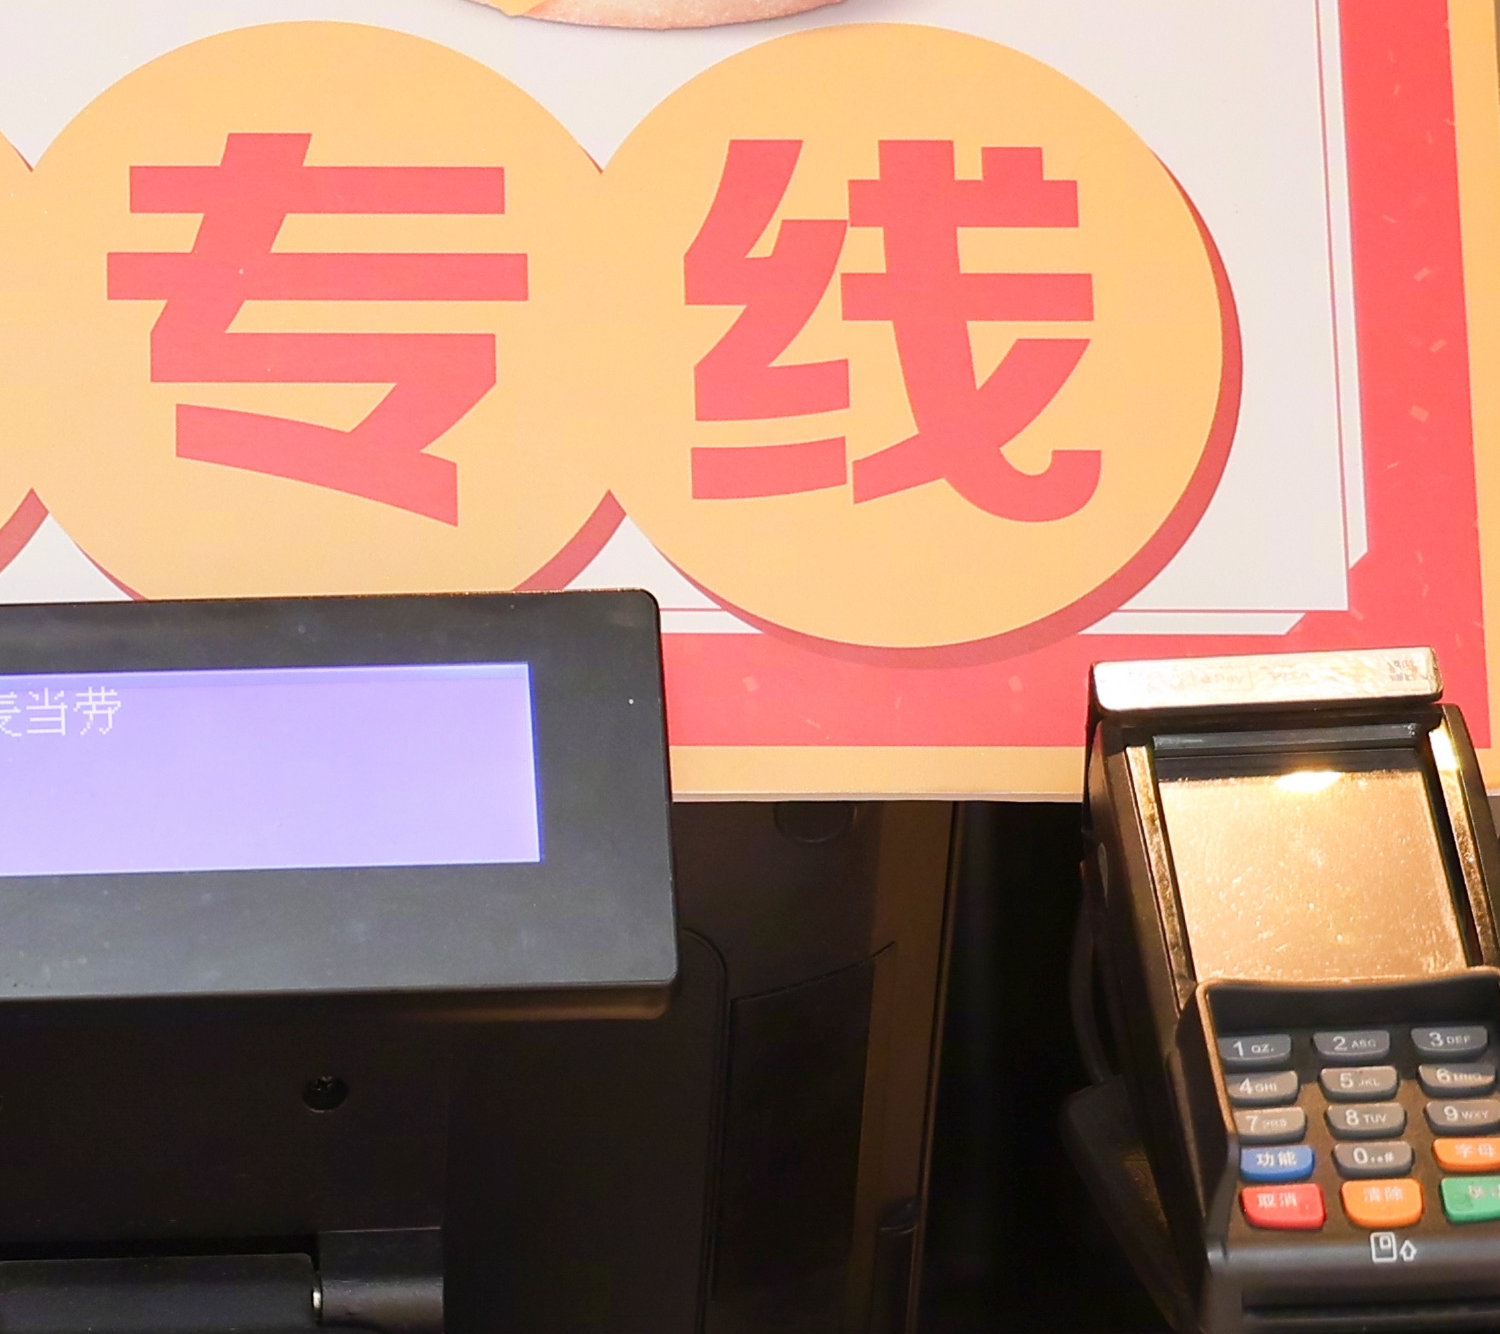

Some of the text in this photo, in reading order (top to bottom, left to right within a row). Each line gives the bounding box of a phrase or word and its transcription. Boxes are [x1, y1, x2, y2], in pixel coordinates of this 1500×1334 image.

[1332, 1035, 1348, 1052] 2
[1428, 1031, 1471, 1047] 3 DEF
[1232, 1040, 1244, 1057] 1
[1339, 1072, 1353, 1088] 5
[1435, 1067, 1450, 1083] 6
[1239, 1077, 1278, 1094] 4 GHI
[1345, 1109, 1387, 1126] 8 TUV
[1443, 1105, 1458, 1122] 9
[1245, 1115, 1258, 1133] 7
[1256, 1149, 1297, 1167] 功能
[1352, 1147, 1368, 1165] 0
[1453, 1143, 1496, 1160] 字母
[1256, 1191, 1298, 1208] 取消
[1362, 1185, 1404, 1203] 清除
